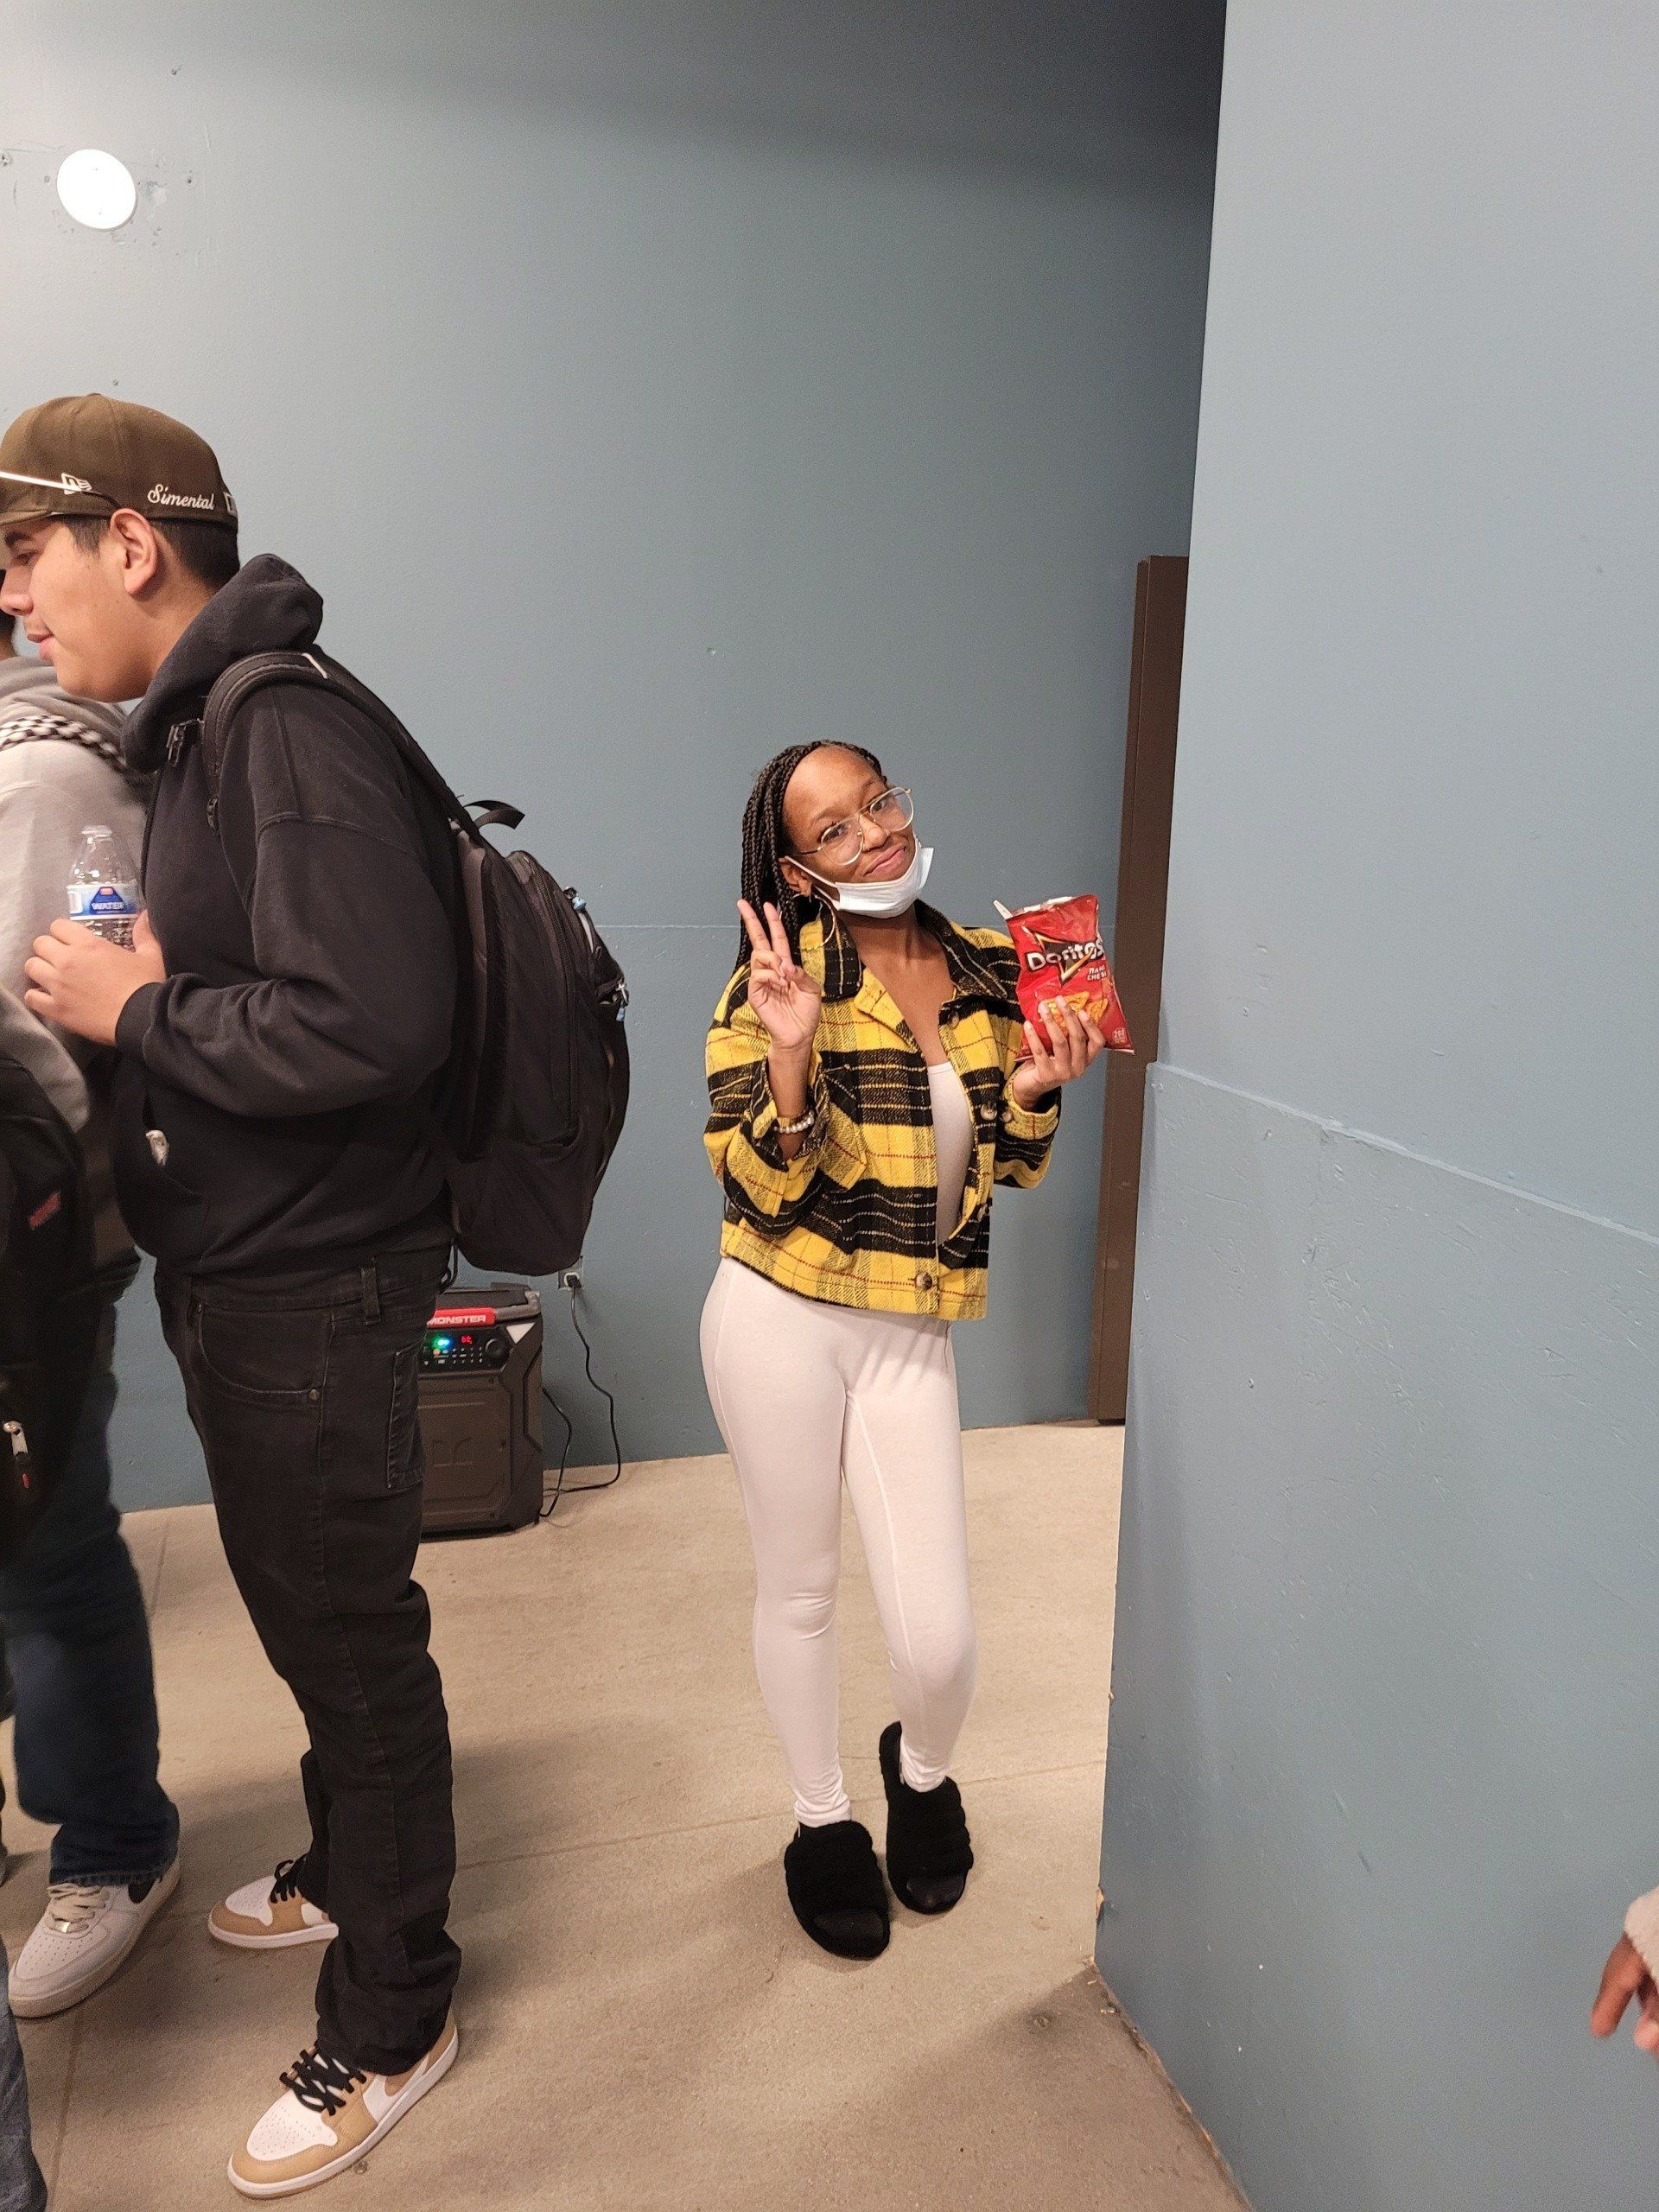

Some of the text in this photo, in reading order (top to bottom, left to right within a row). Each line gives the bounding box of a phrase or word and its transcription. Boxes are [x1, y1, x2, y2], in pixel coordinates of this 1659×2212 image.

[147, 484, 215, 510] Simental
[1026, 940, 1104, 971] Doritos
[430, 1315, 486, 1325] MONSTER
